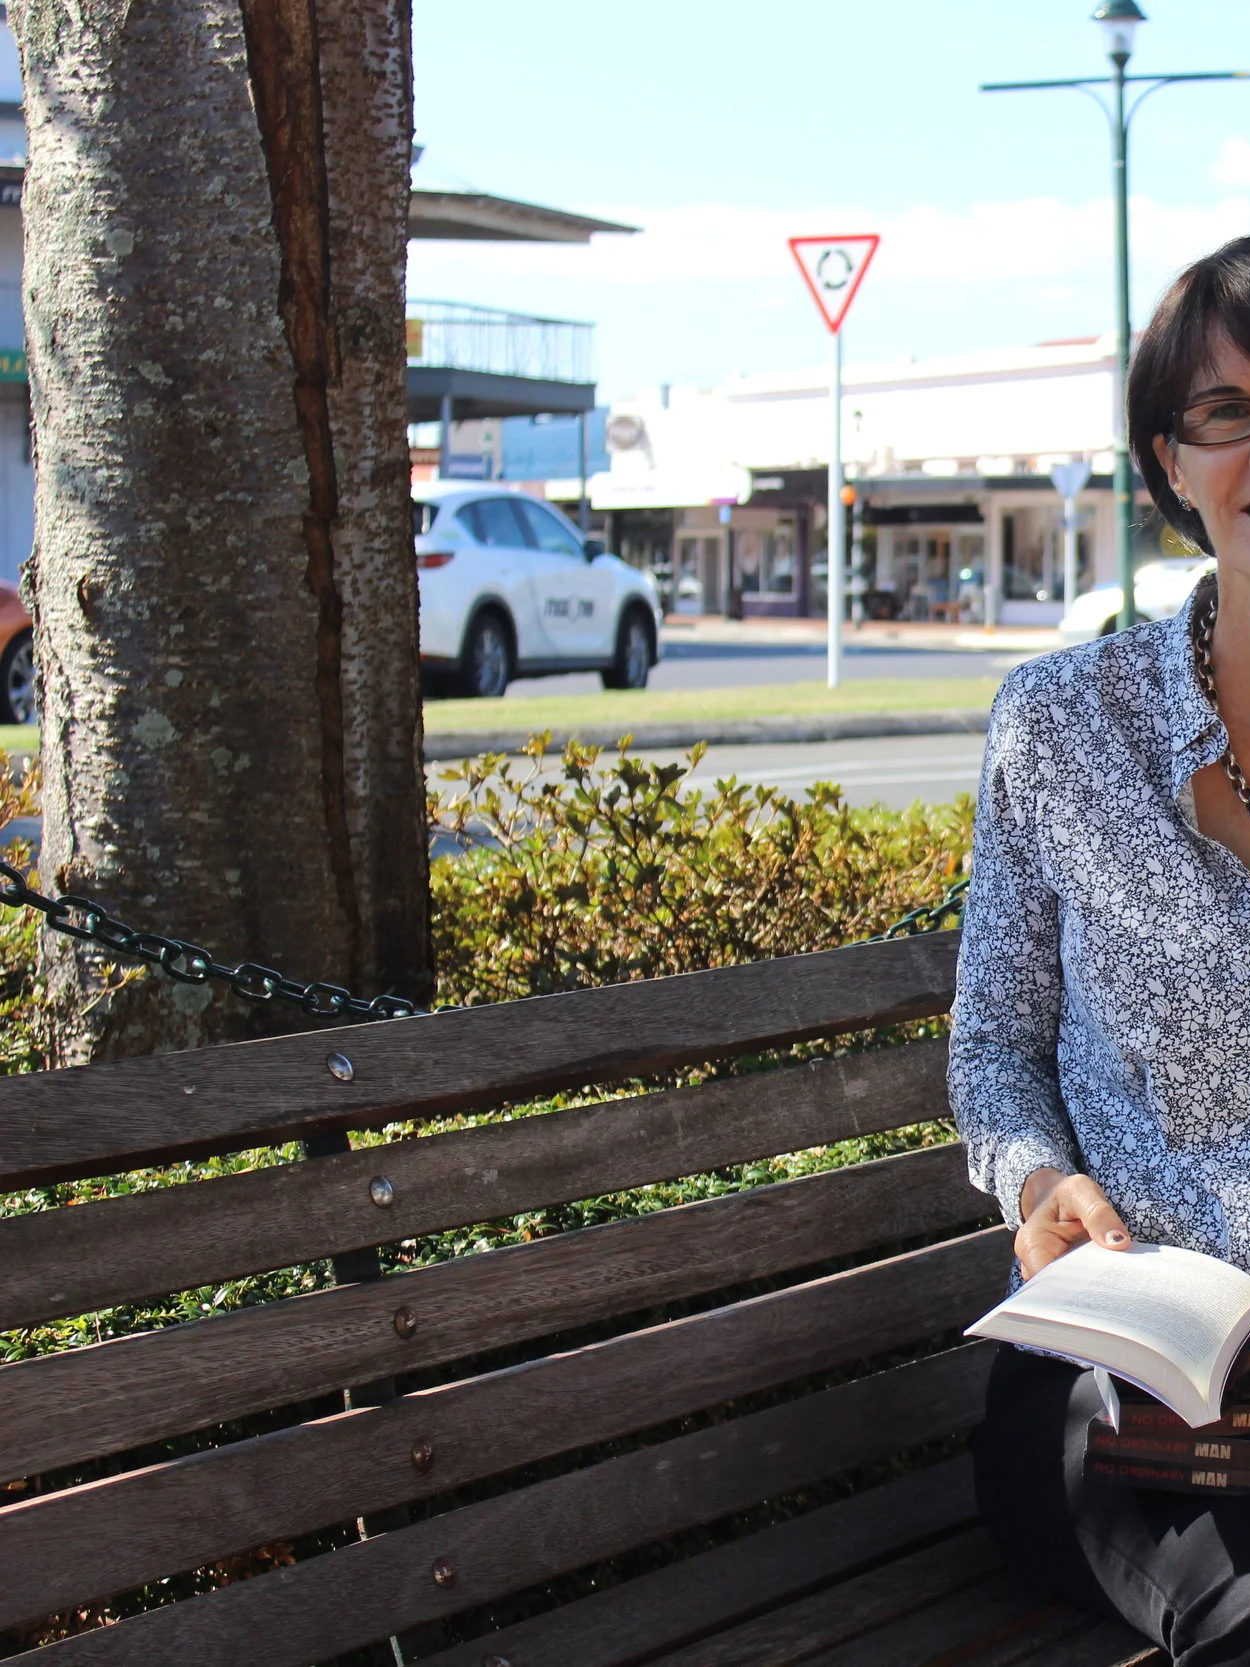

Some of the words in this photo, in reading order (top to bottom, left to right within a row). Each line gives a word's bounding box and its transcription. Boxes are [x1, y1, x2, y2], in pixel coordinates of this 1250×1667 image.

[1131, 1415, 1153, 1425] NO
[1096, 1436, 1117, 1447] NO
[1120, 1437, 1190, 1452] ORDINARY
[1194, 1442, 1231, 1460] MAN
[1094, 1462, 1116, 1475] NO
[1119, 1464, 1187, 1480] ORDINARY
[1191, 1470, 1228, 1487] MAN
